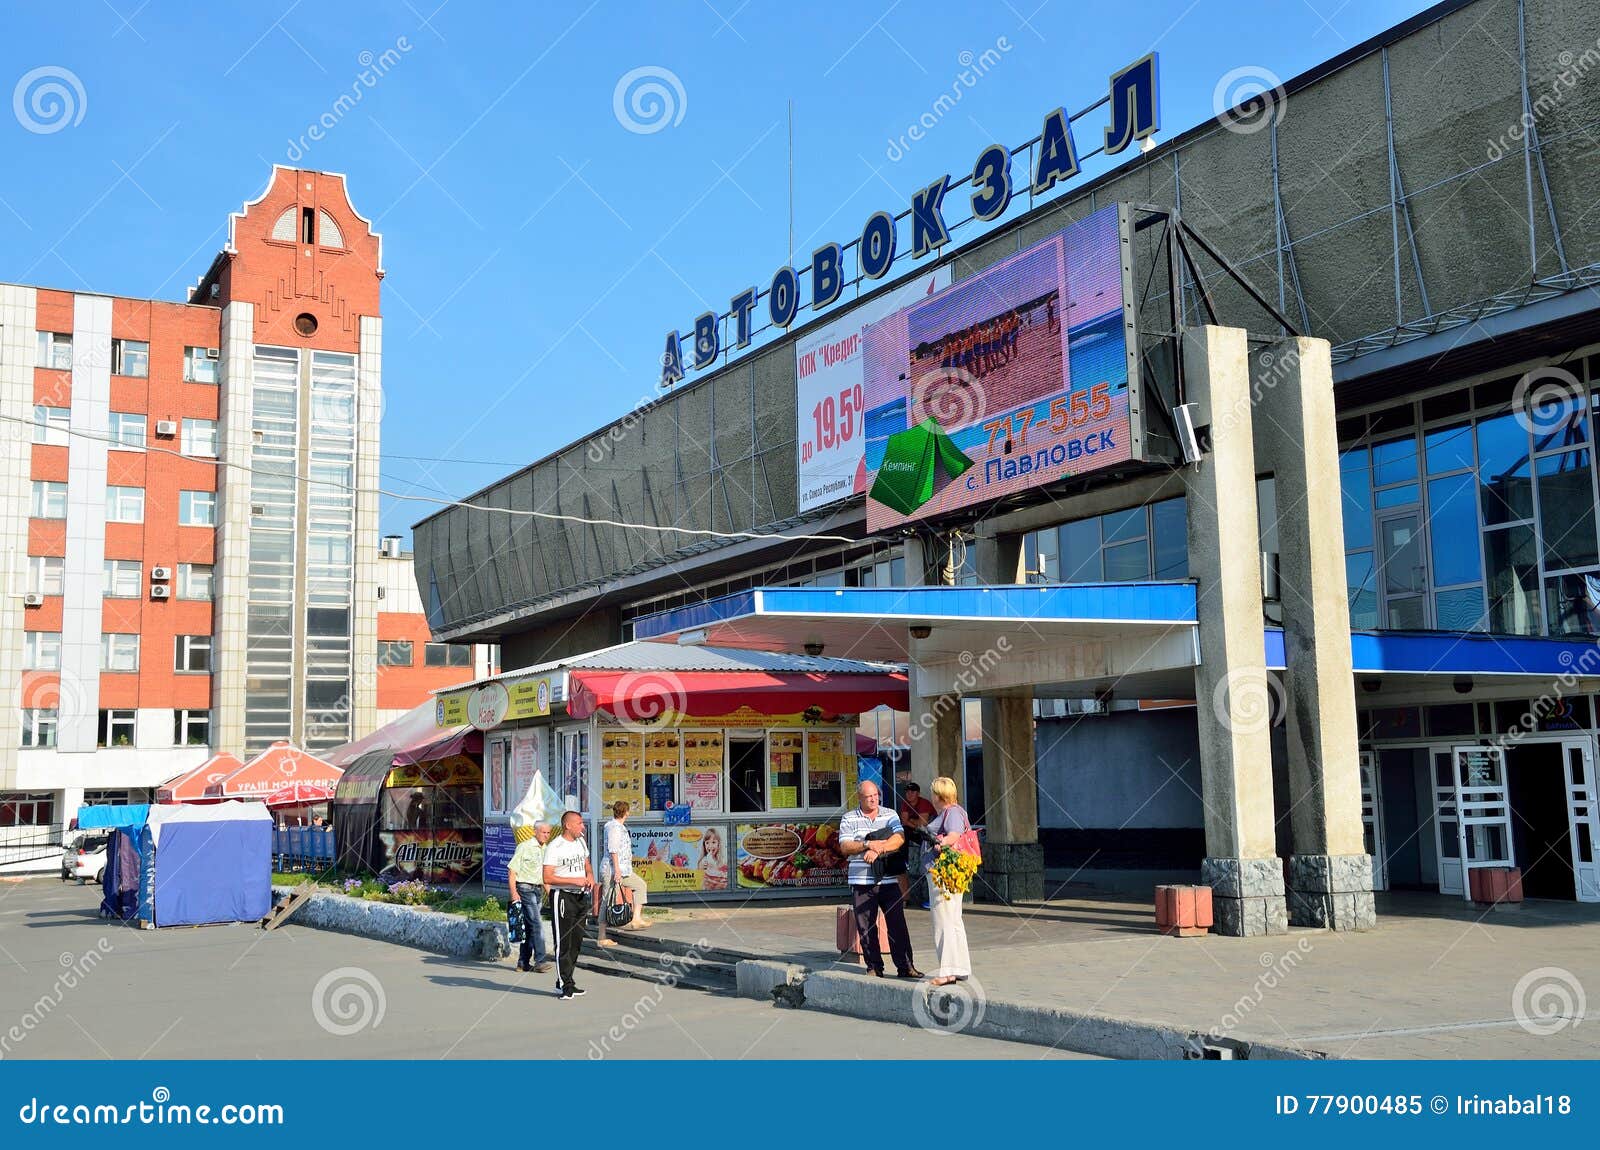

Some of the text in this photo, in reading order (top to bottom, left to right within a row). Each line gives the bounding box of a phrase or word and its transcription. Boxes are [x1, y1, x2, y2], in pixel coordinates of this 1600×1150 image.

[660, 51, 1162, 388] АВТОВОКЗАЛ
[799, 350, 817, 380] КПК
[983, 381, 1112, 455] 717-555
[801, 440, 813, 465] до
[984, 427, 1117, 486] Павловск
[396, 841, 473, 864] Adrenaline
